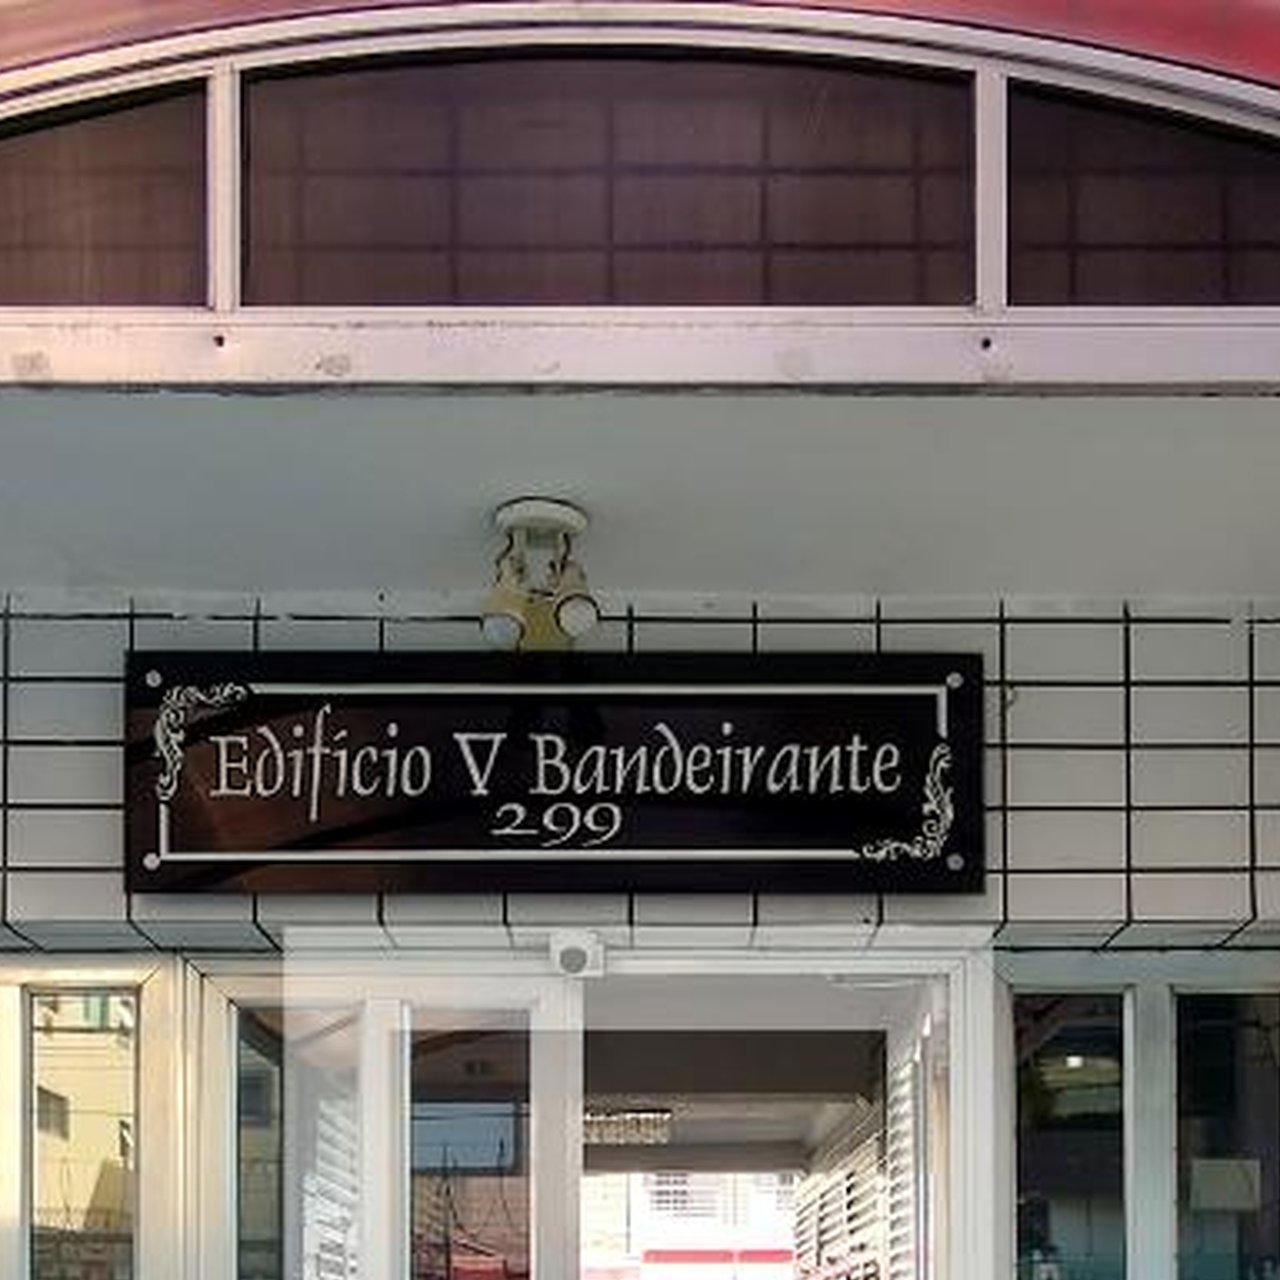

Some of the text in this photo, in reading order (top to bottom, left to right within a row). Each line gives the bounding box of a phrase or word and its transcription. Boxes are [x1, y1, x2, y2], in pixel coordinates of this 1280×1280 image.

[208, 702, 902, 823] Edifício V Bandeirante
[490, 801, 622, 848] 299
